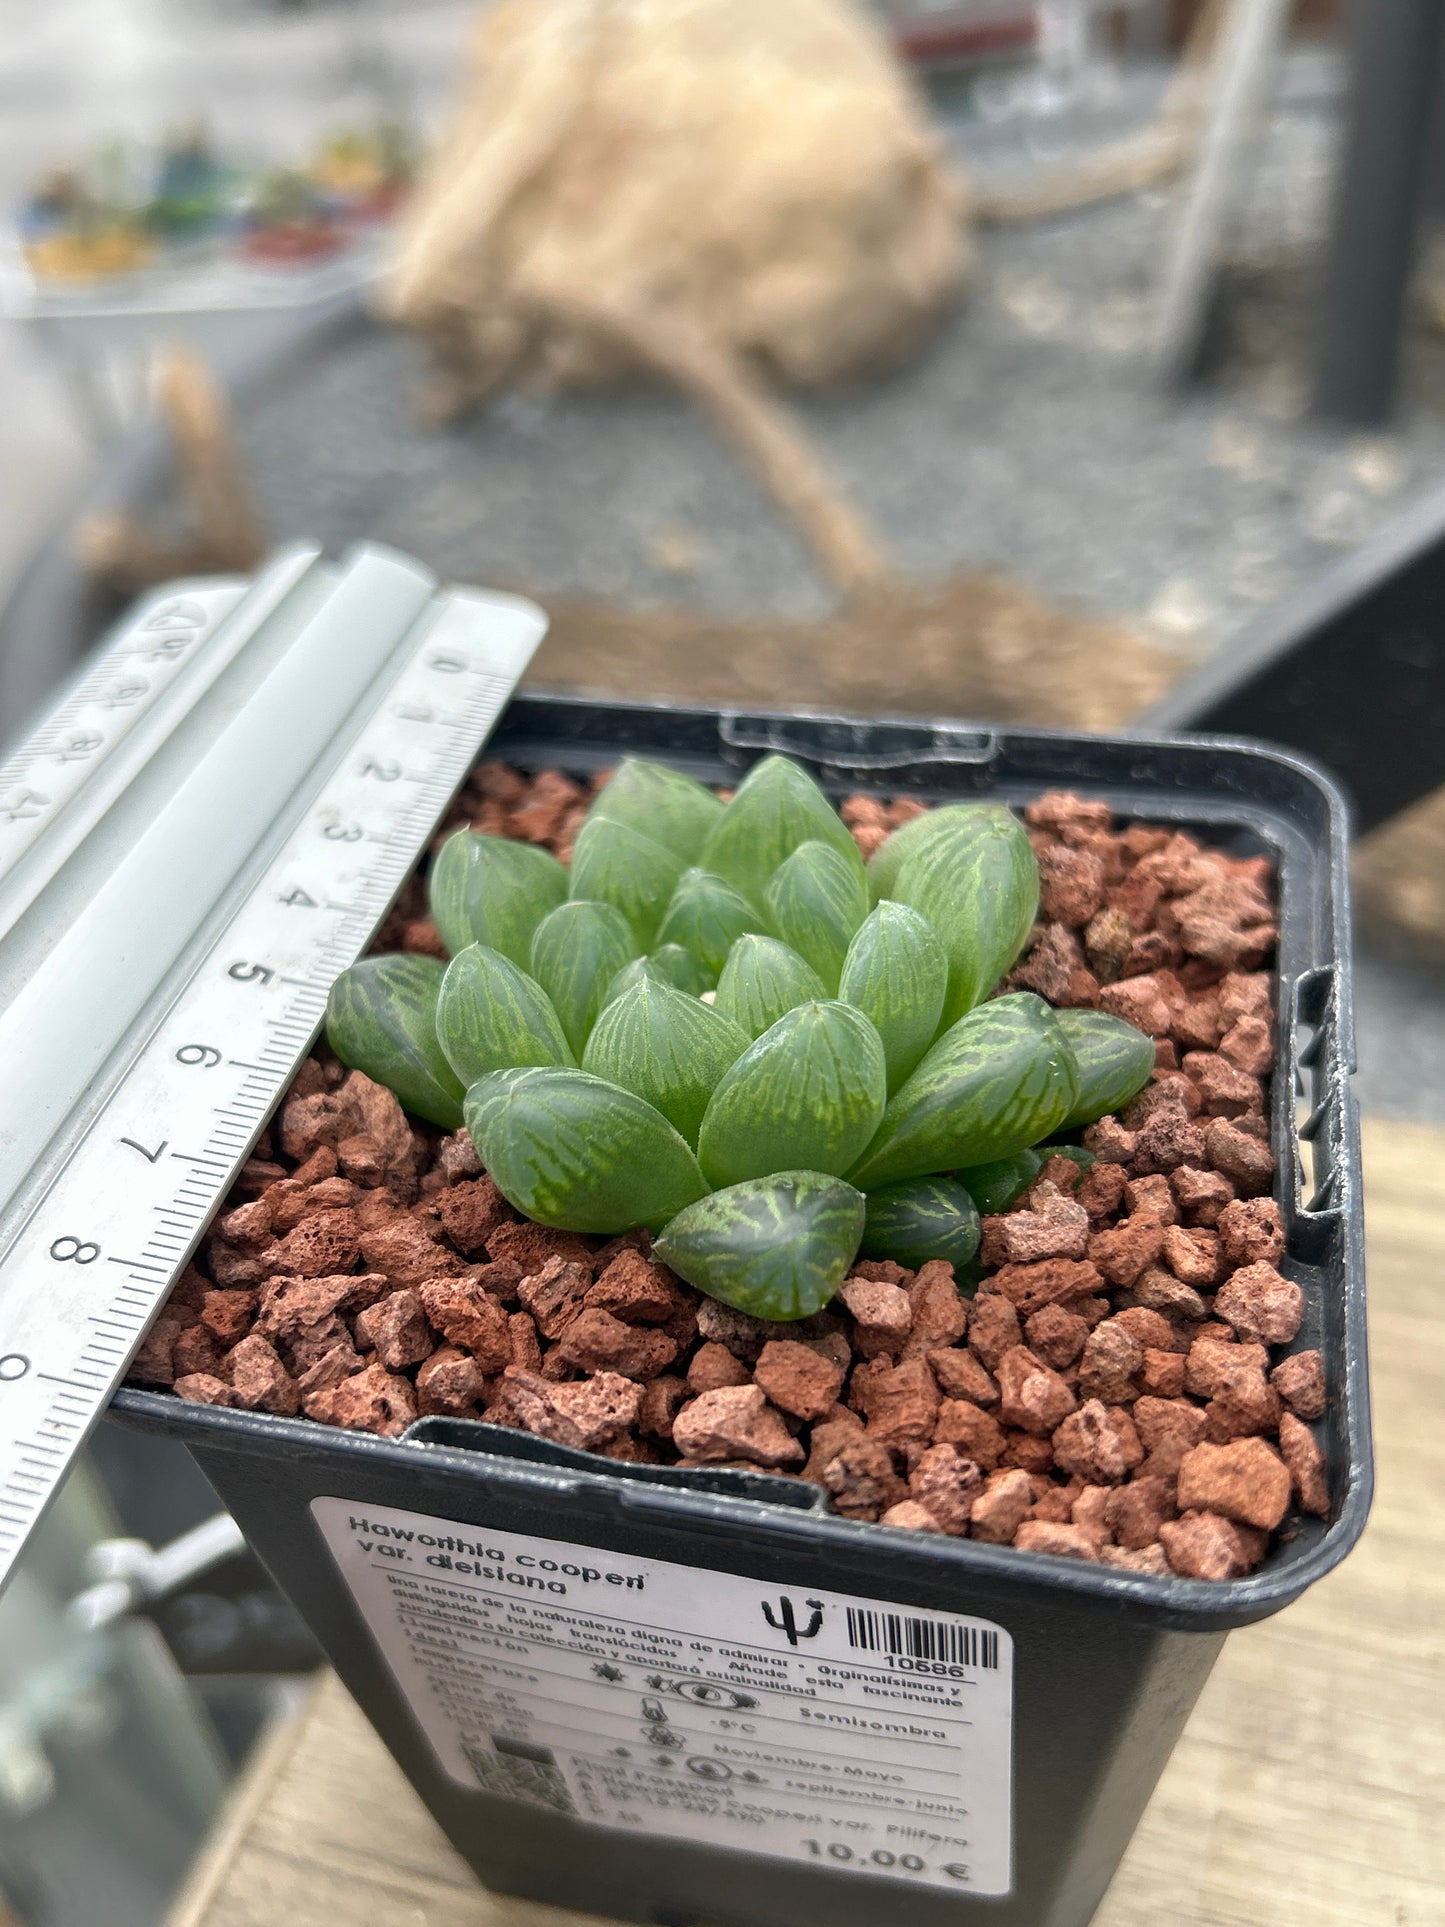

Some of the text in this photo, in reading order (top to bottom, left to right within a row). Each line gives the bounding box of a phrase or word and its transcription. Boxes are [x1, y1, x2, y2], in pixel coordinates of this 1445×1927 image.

[357, 753, 402, 782] 2
[322, 819, 364, 843] 3
[278, 887, 319, 908] 4
[227, 961, 275, 985] 5
[175, 1043, 222, 1068] 6
[119, 1137, 169, 1163] 7
[50, 1235, 101, 1265] 8
[349, 1515, 646, 1591] Haworthia cooperi
[356, 1539, 567, 1596] var. dielsiana
[387, 1574, 419, 1590] Una
[424, 1583, 479, 1603] rareza
[481, 1596, 505, 1609] de
[509, 1602, 527, 1614] la
[532, 1609, 627, 1636] naturaleza
[631, 1629, 684, 1648] digna
[689, 1641, 713, 1653] de
[718, 1647, 789, 1668] admirar
[950, 1686, 961, 1697] y
[392, 1588, 964, 1708] distinguidas hojas translúcidas Añade esta fascinante
[398, 1601, 480, 1628] suculenta
[497, 1622, 515, 1635] tu
[518, 1629, 607, 1656] colección
[625, 1652, 702, 1676] aportará
[884, 1655, 964, 1678] 10586
[799, 1706, 947, 1739] Semisombra
